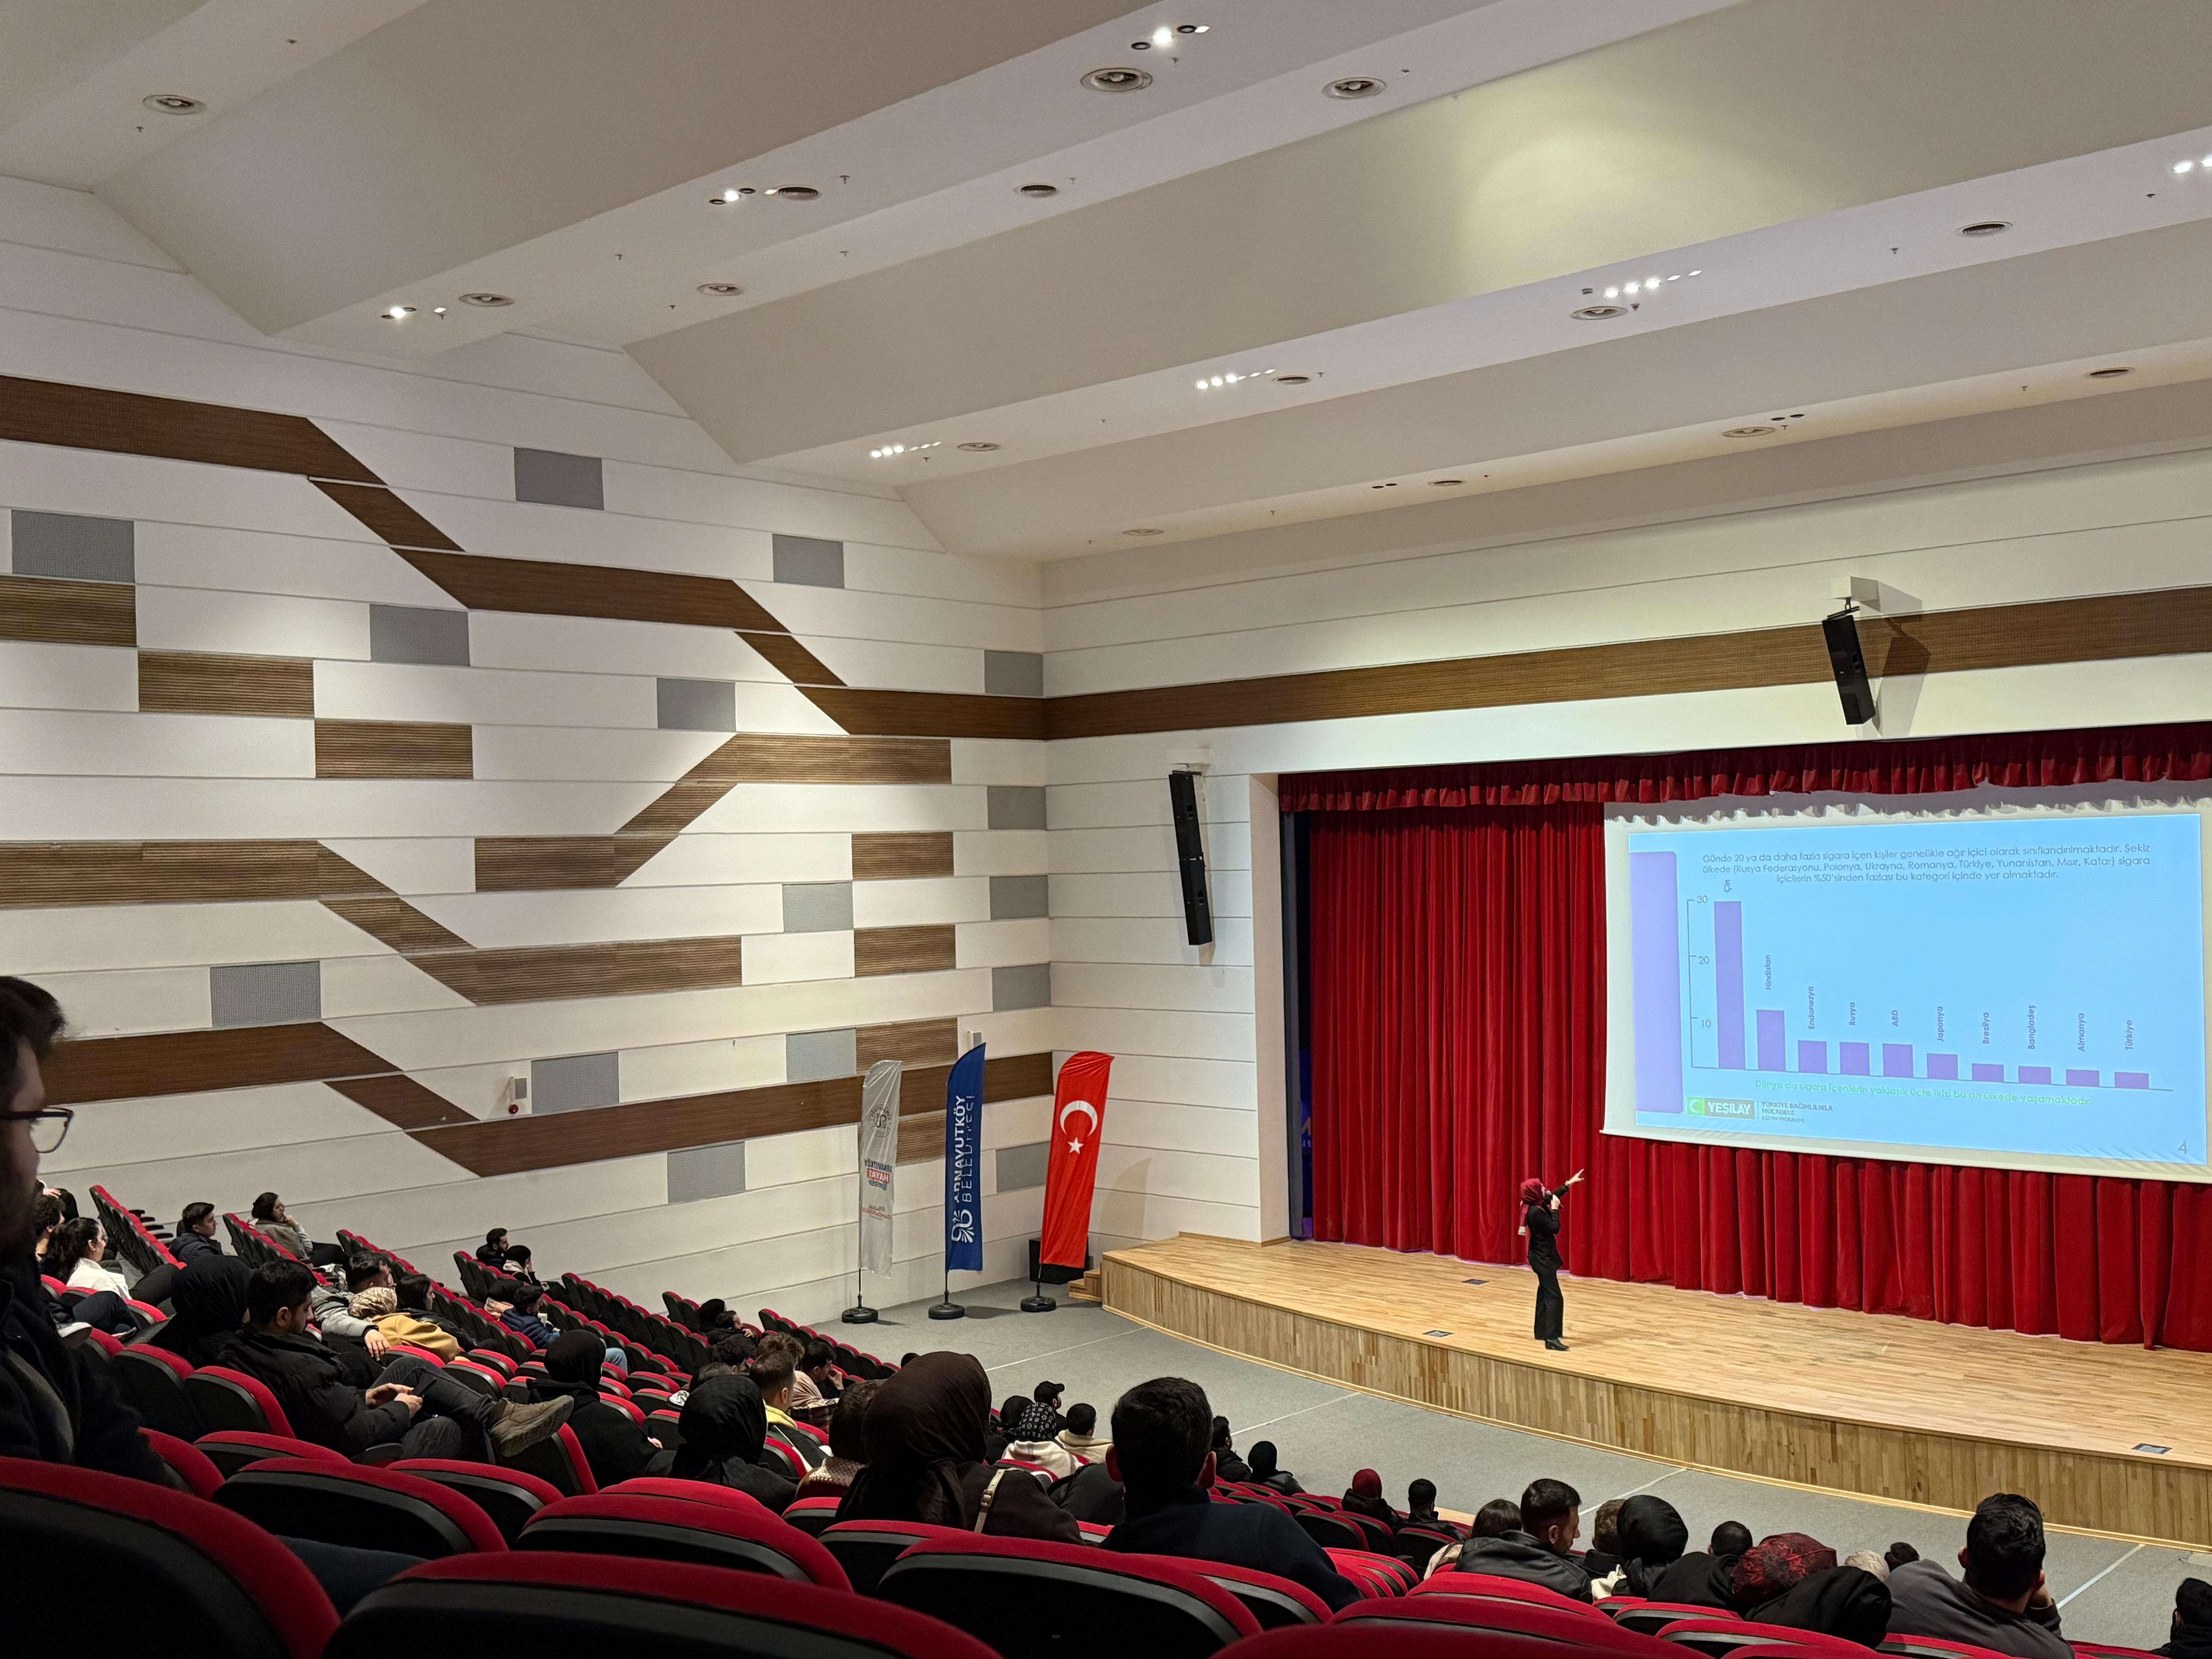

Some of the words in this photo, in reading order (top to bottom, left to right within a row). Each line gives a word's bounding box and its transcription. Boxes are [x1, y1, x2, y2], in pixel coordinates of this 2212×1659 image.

[1703, 854, 1732, 864] Günde
[1734, 854, 1744, 862] 20
[1746, 856, 1757, 864] ya
[1759, 852, 1771, 861] da
[1773, 852, 1797, 861] daha
[1799, 851, 1820, 860] fazla
[1823, 851, 1850, 862] sigara
[1852, 850, 1872, 861] içen
[1874, 850, 1897, 861] kişiler
[1901, 849, 1944, 860] genellikle
[1947, 849, 1965, 858] ağır
[1968, 848, 1987, 857] içici
[1990, 847, 2021, 855] olarak
[2023, 844, 2122, 855] sınıflandırılmaktadır.
[2125, 843, 2150, 853] Sekiz
[1703, 864, 1731, 873] ülkede
[1733, 864, 1761, 874] (Rusya
[1763, 863, 1821, 874] Federasyonu,
[1824, 863, 1863, 872] Polonya,
[1865, 862, 1905, 871] Ukrayna,
[1908, 861, 1956, 870] Romanya,
[1959, 859, 1994, 869] Türkiye,
[1997, 858, 2054, 868] Yunanistan,
[2057, 858, 2081, 867] Mısır,
[2084, 857, 2114, 867] Katar)
[2118, 856, 2150, 866] sigara
[1777, 873, 1812, 883] içicilerin
[1814, 872, 1864, 882] %50'sinden
[1866, 872, 1894, 881] fazlası
[1910, 871, 1950, 882] kategori
[1952, 871, 1982, 880] içinde
[1984, 872, 2000, 880] yer
[2003, 871, 2059, 879] almaktadır.
[1724, 879, 1732, 893] Çin
[1696, 895, 1708, 904] 30
[1698, 956, 1710, 964] 20
[1702, 1020, 1711, 1028] 10
[1982, 1012, 1990, 1044] Brezilya
[2028, 1005, 2036, 1049] Bangladeş
[2077, 1013, 2086, 1052] Almanya
[2125, 1020, 2135, 1050] Türkiye
[1799, 1084, 1826, 1092] sigara
[1829, 1084, 1867, 1093] içenlerin
[1910, 1088, 1931, 1096] üçte
[1934, 1089, 1951, 1097] ikisi
[1984, 1092, 2018, 1101] ülkede
[1707, 1101, 1751, 1116] YEŞİLAY
[2178, 1141, 2188, 1154] 4
